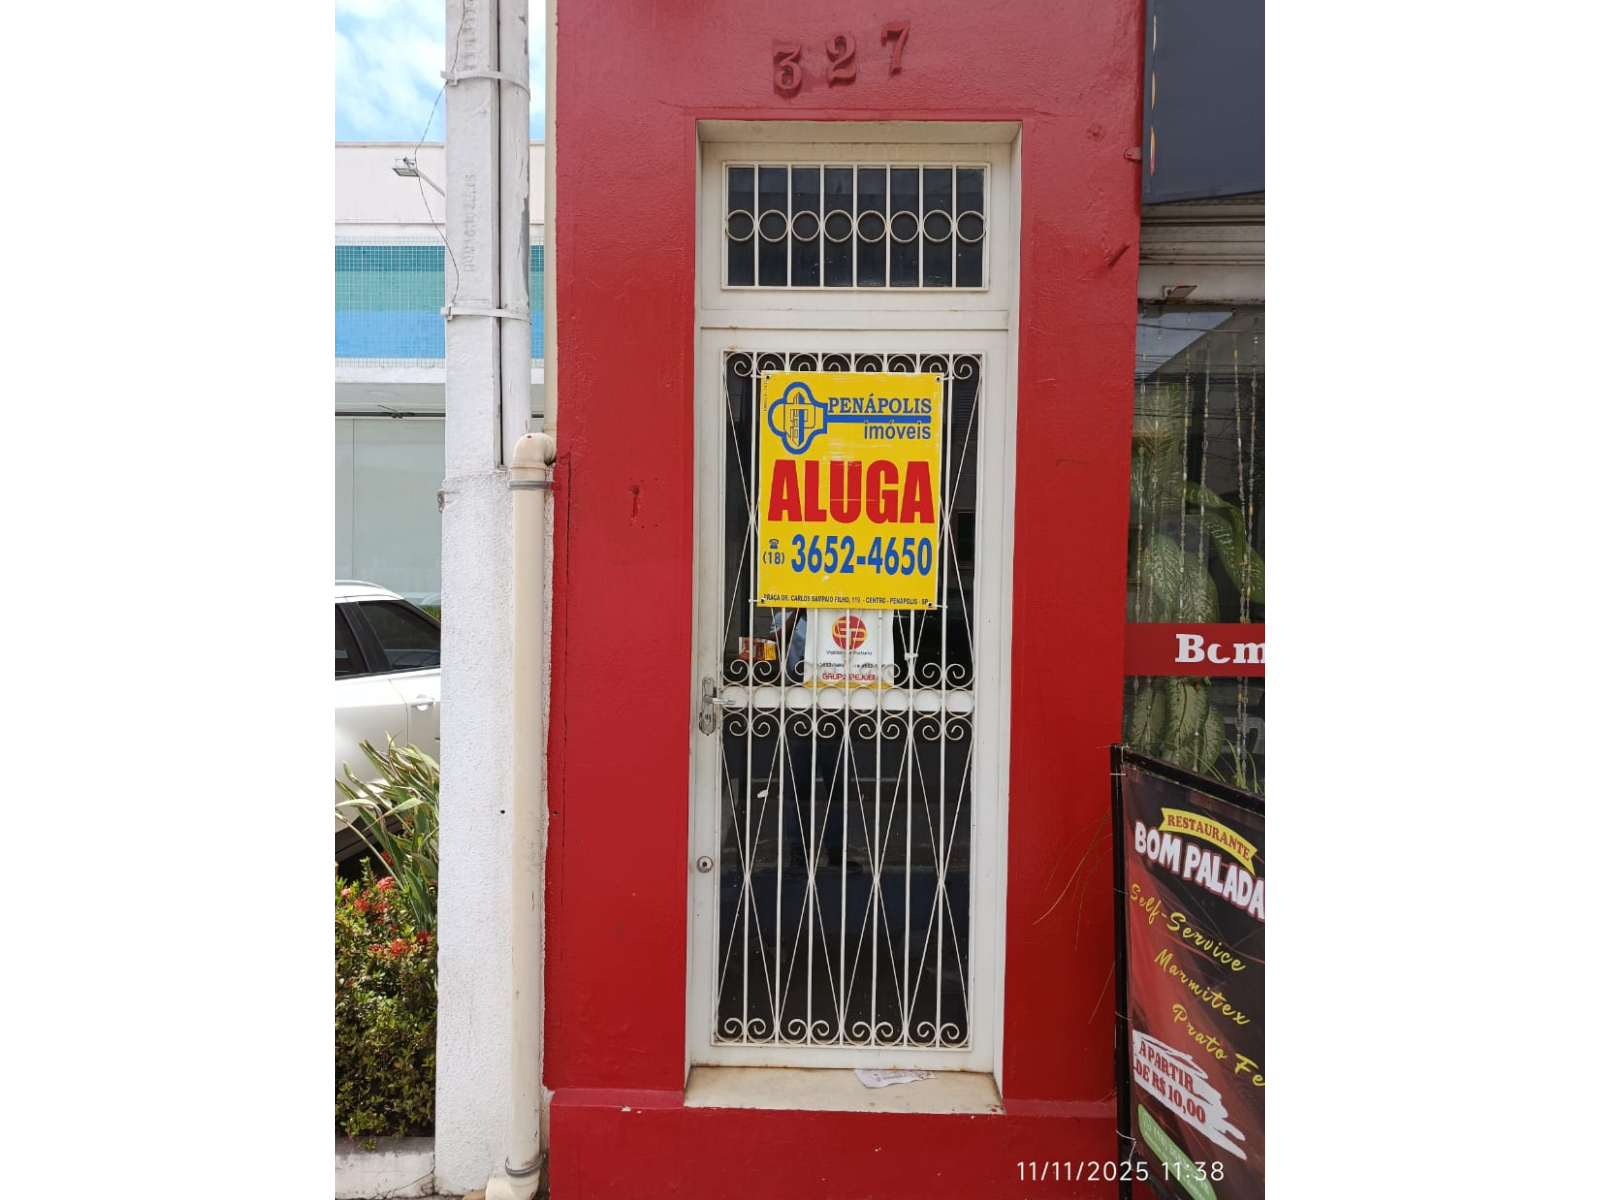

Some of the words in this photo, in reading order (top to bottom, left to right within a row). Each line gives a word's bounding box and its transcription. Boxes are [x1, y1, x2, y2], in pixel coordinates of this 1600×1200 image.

[773, 21, 910, 98] 327
[827, 393, 932, 415] PENÁPOLIS
[864, 420, 932, 440] imóveis
[767, 459, 935, 524] ALUGA
[762, 551, 785, 566] (18)
[791, 533, 933, 576] 3652-4650
[1134, 820, 1182, 873] BOM
[1183, 843, 1265, 920] PALADA
[1167, 814, 1251, 861] RESTAURANTE
[1130, 883, 1246, 972] Self-Service
[1154, 948, 1250, 1025] Marmitex
[1172, 1003, 1228, 1060] Prato
[1235, 1053, 1265, 1087] Fe
[1135, 1058, 1150, 1083] DE
[1152, 1070, 1167, 1097] R$
[1168, 1084, 1206, 1125] 10,00
